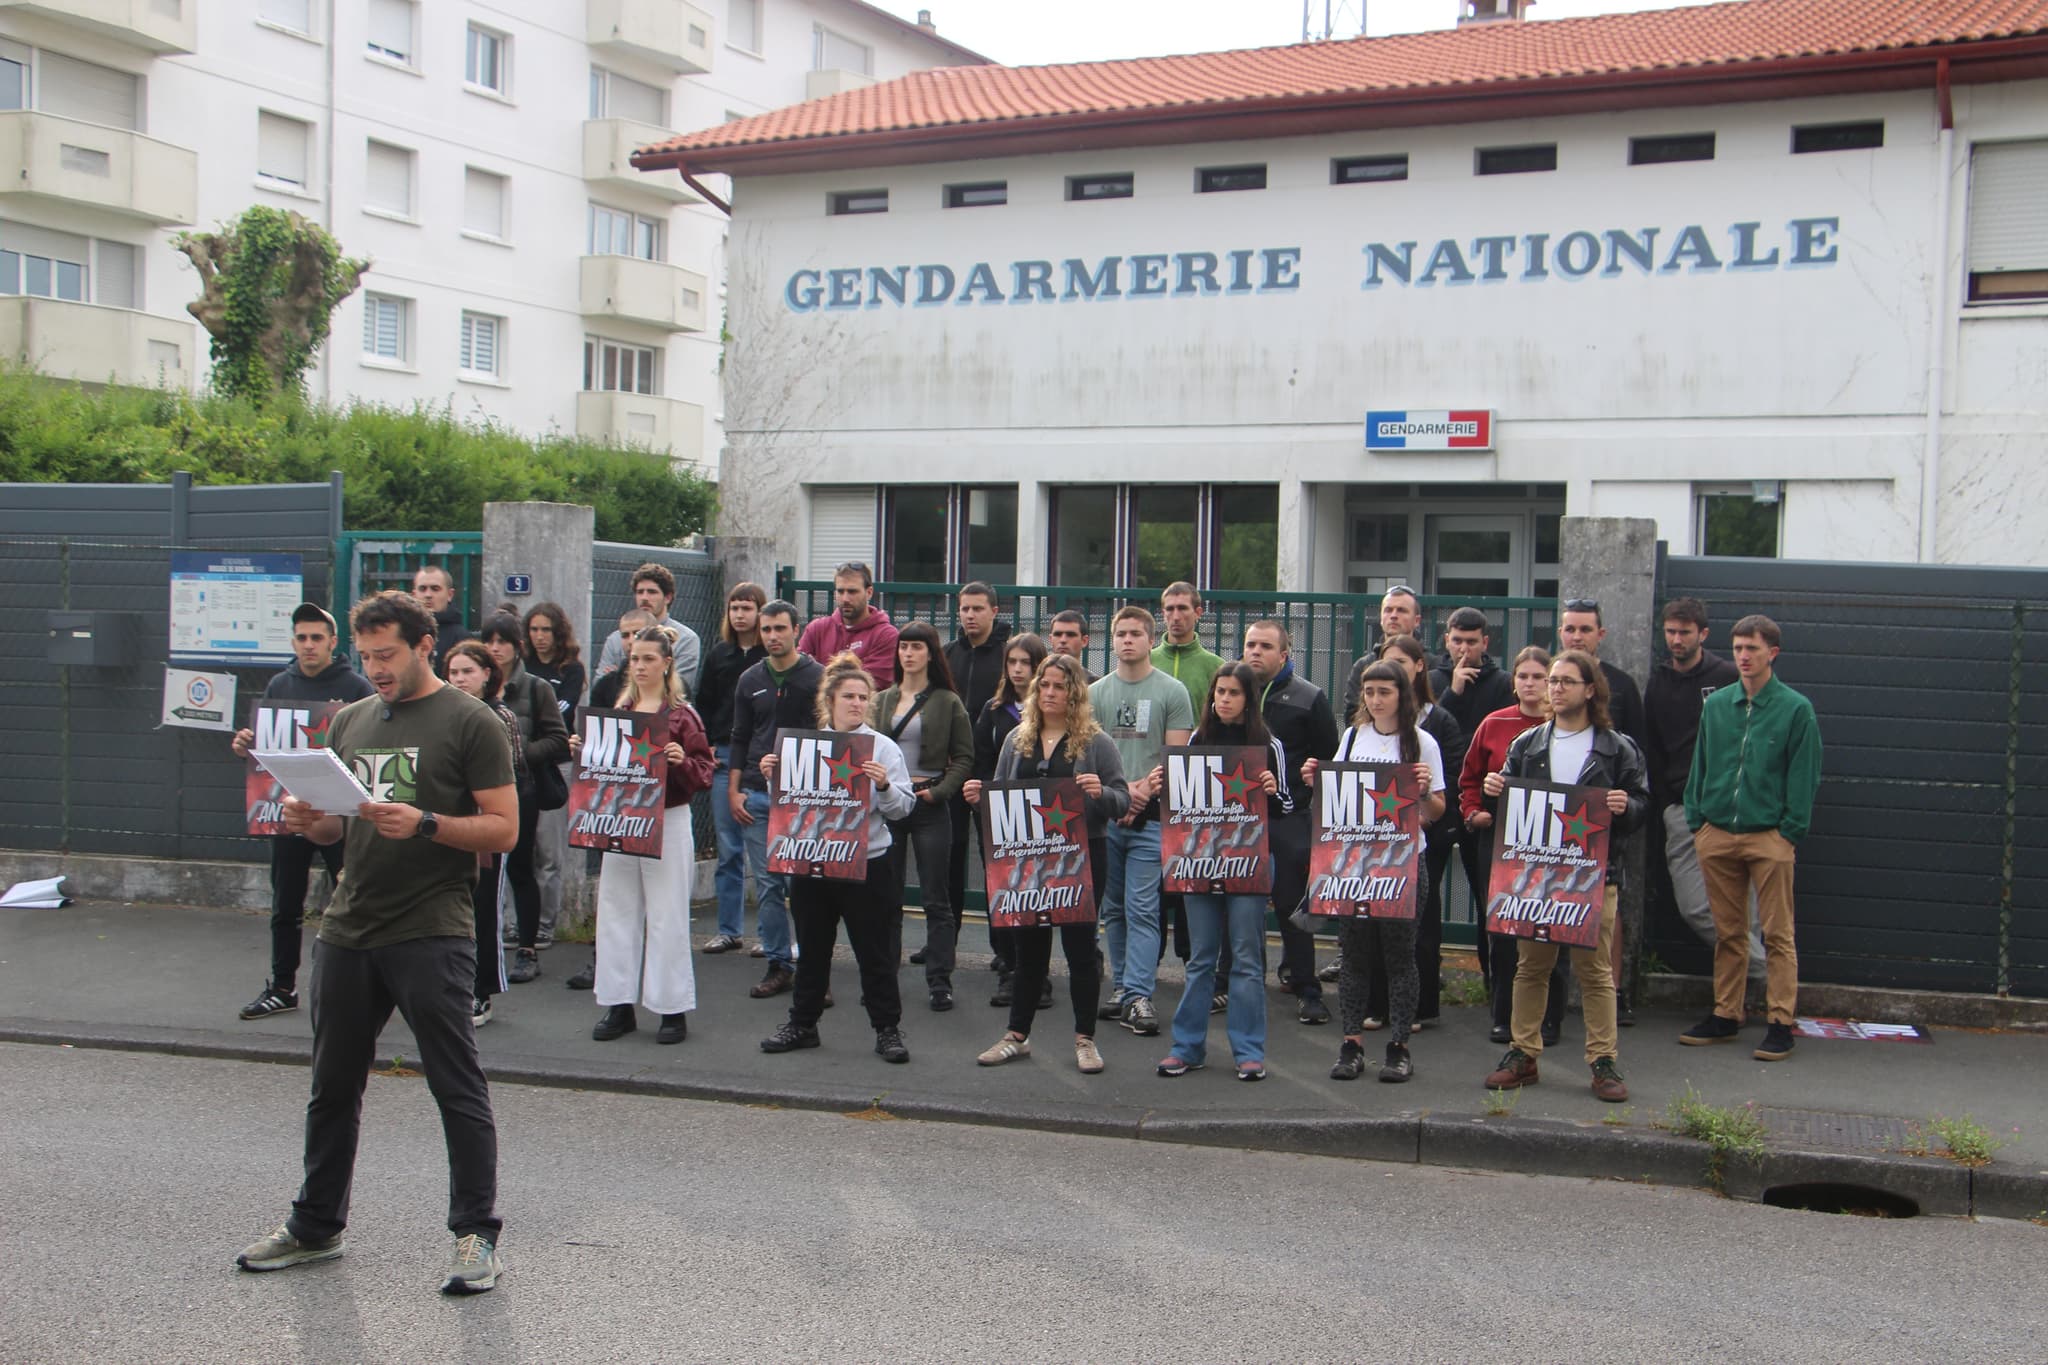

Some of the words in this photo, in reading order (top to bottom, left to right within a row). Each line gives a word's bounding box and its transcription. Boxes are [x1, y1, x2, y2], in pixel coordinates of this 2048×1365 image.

[784, 247, 1301, 312] GENDARMERIE
[1360, 216, 1840, 290] NATIONALE
[1379, 423, 1477, 435] GENDARMERIE
[514, 577, 522, 591] 9
[577, 812, 655, 838] ANTOLATU!
[776, 838, 858, 863] ANTOLATU!
[1172, 855, 1259, 880] ANTOLATU!
[998, 884, 1082, 914] ANTOLATU!
[1319, 876, 1407, 901] ANTOLATU!
[1496, 895, 1591, 927] ANTOLATU!
